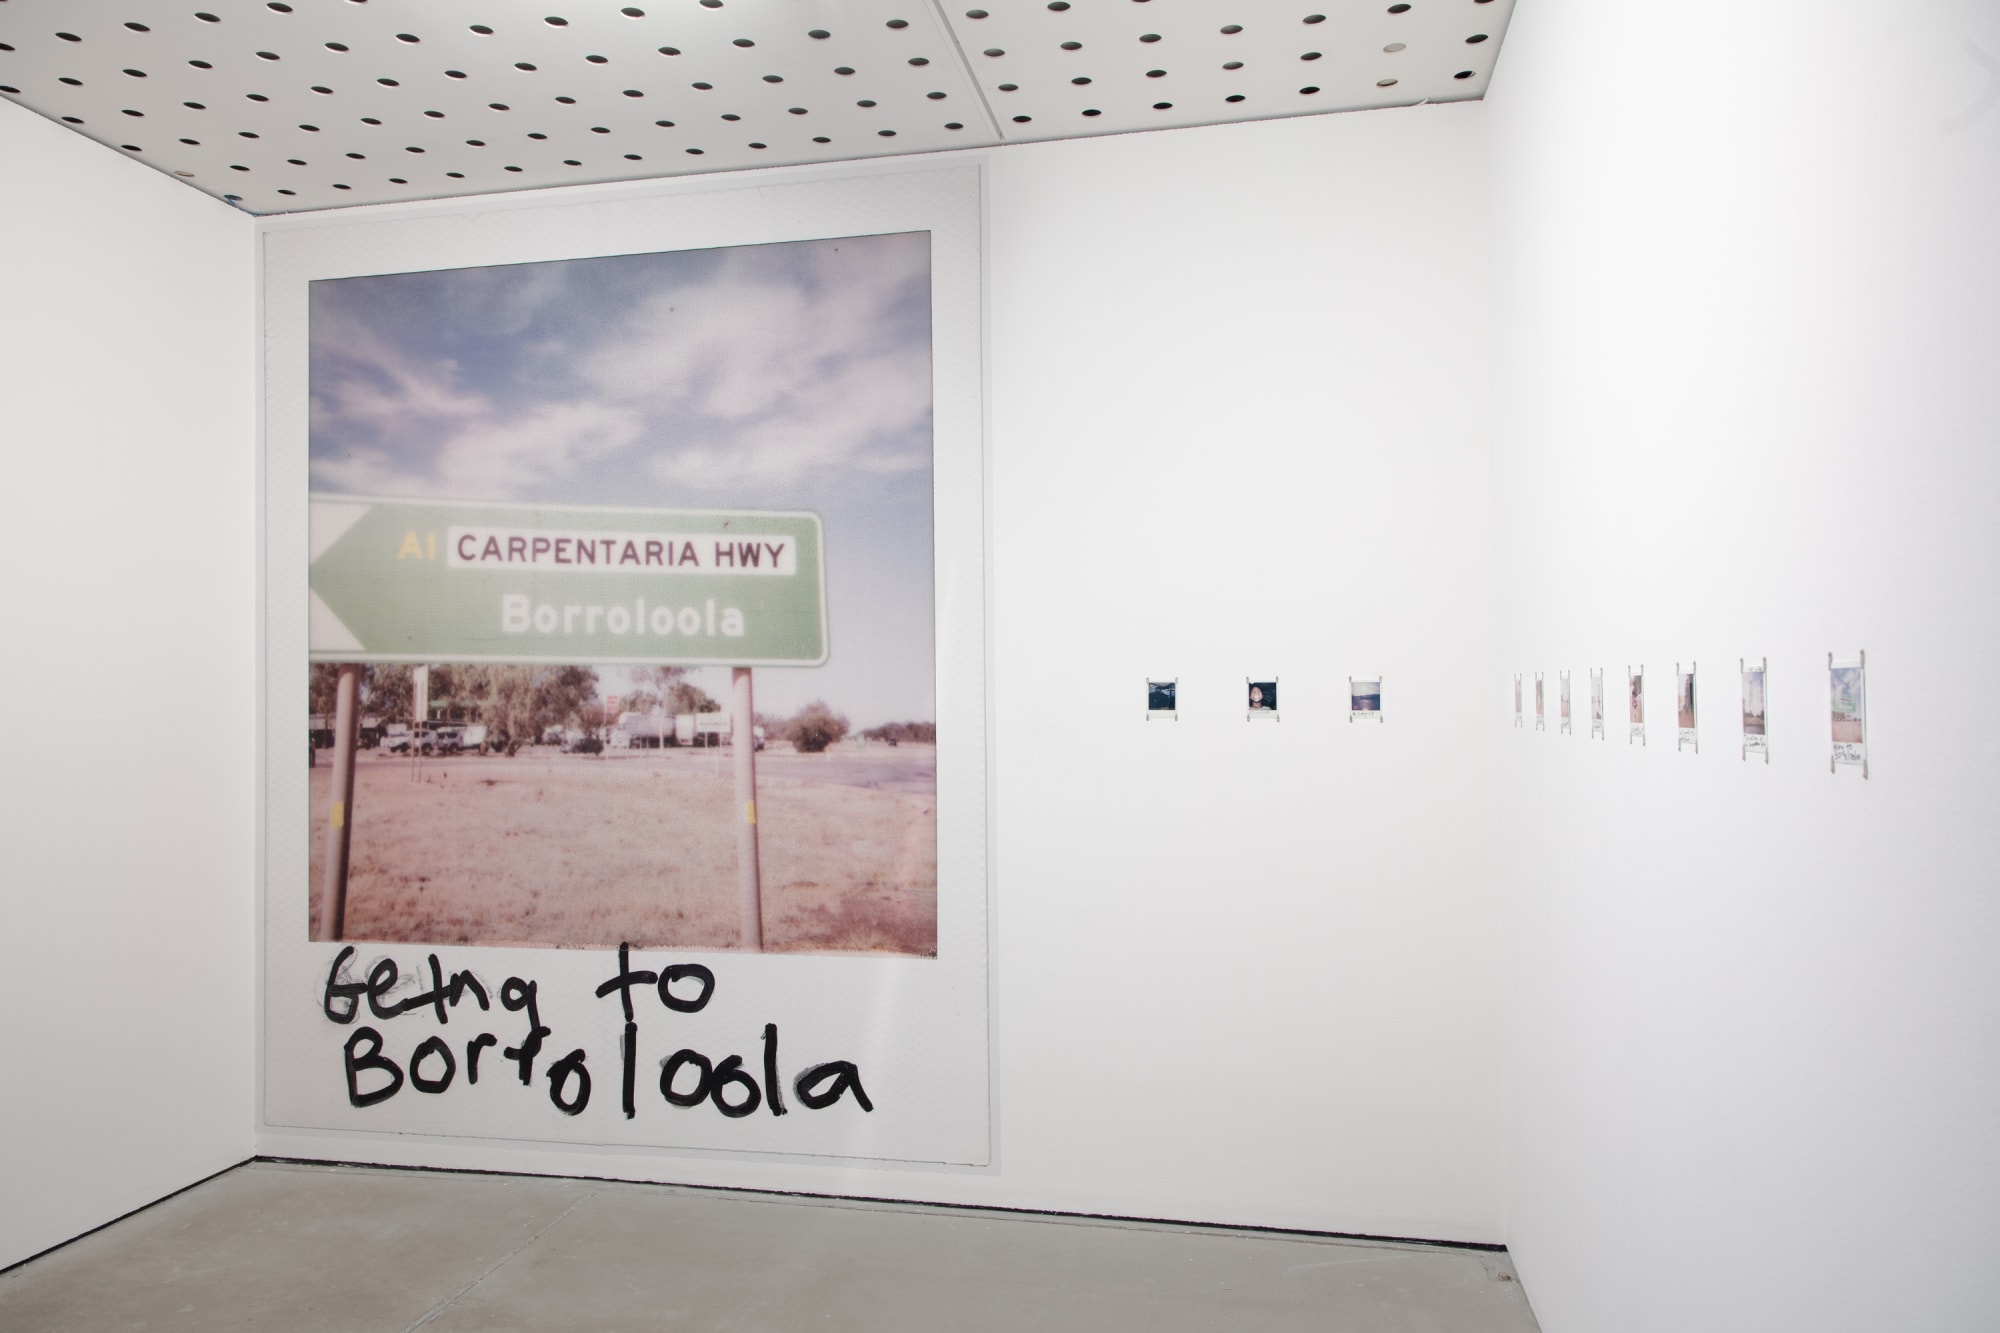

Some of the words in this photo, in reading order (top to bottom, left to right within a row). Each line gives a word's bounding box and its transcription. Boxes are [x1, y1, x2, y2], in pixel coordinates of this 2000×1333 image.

[399, 531, 435, 561] A1
[457, 534, 699, 567] CARPENTARIA
[715, 541, 786, 568] HWY
[503, 595, 744, 637] Borroloola
[596, 942, 715, 1020] to
[344, 1022, 874, 1119] Borroloola
